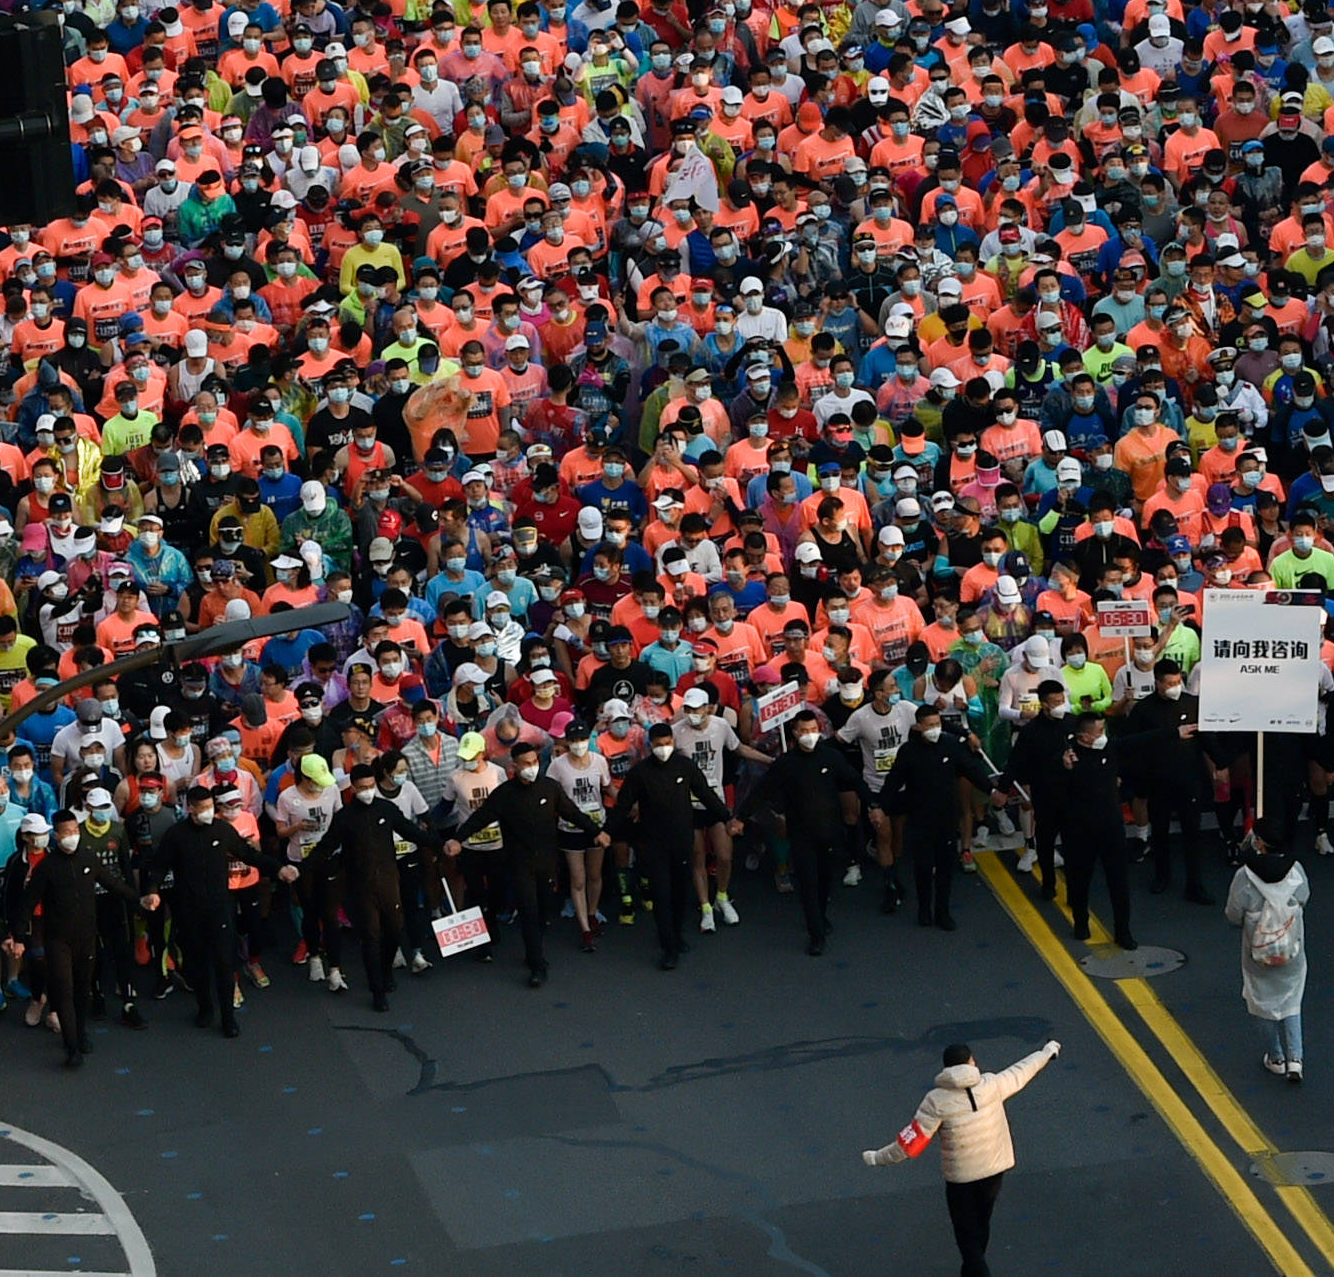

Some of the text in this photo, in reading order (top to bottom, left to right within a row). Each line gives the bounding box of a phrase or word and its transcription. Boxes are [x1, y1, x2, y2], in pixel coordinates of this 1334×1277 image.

[1104, 612, 1143, 626] 05:30
[1213, 639, 1308, 660] 请向我咨询
[1240, 664, 1280, 674] ASK ME
